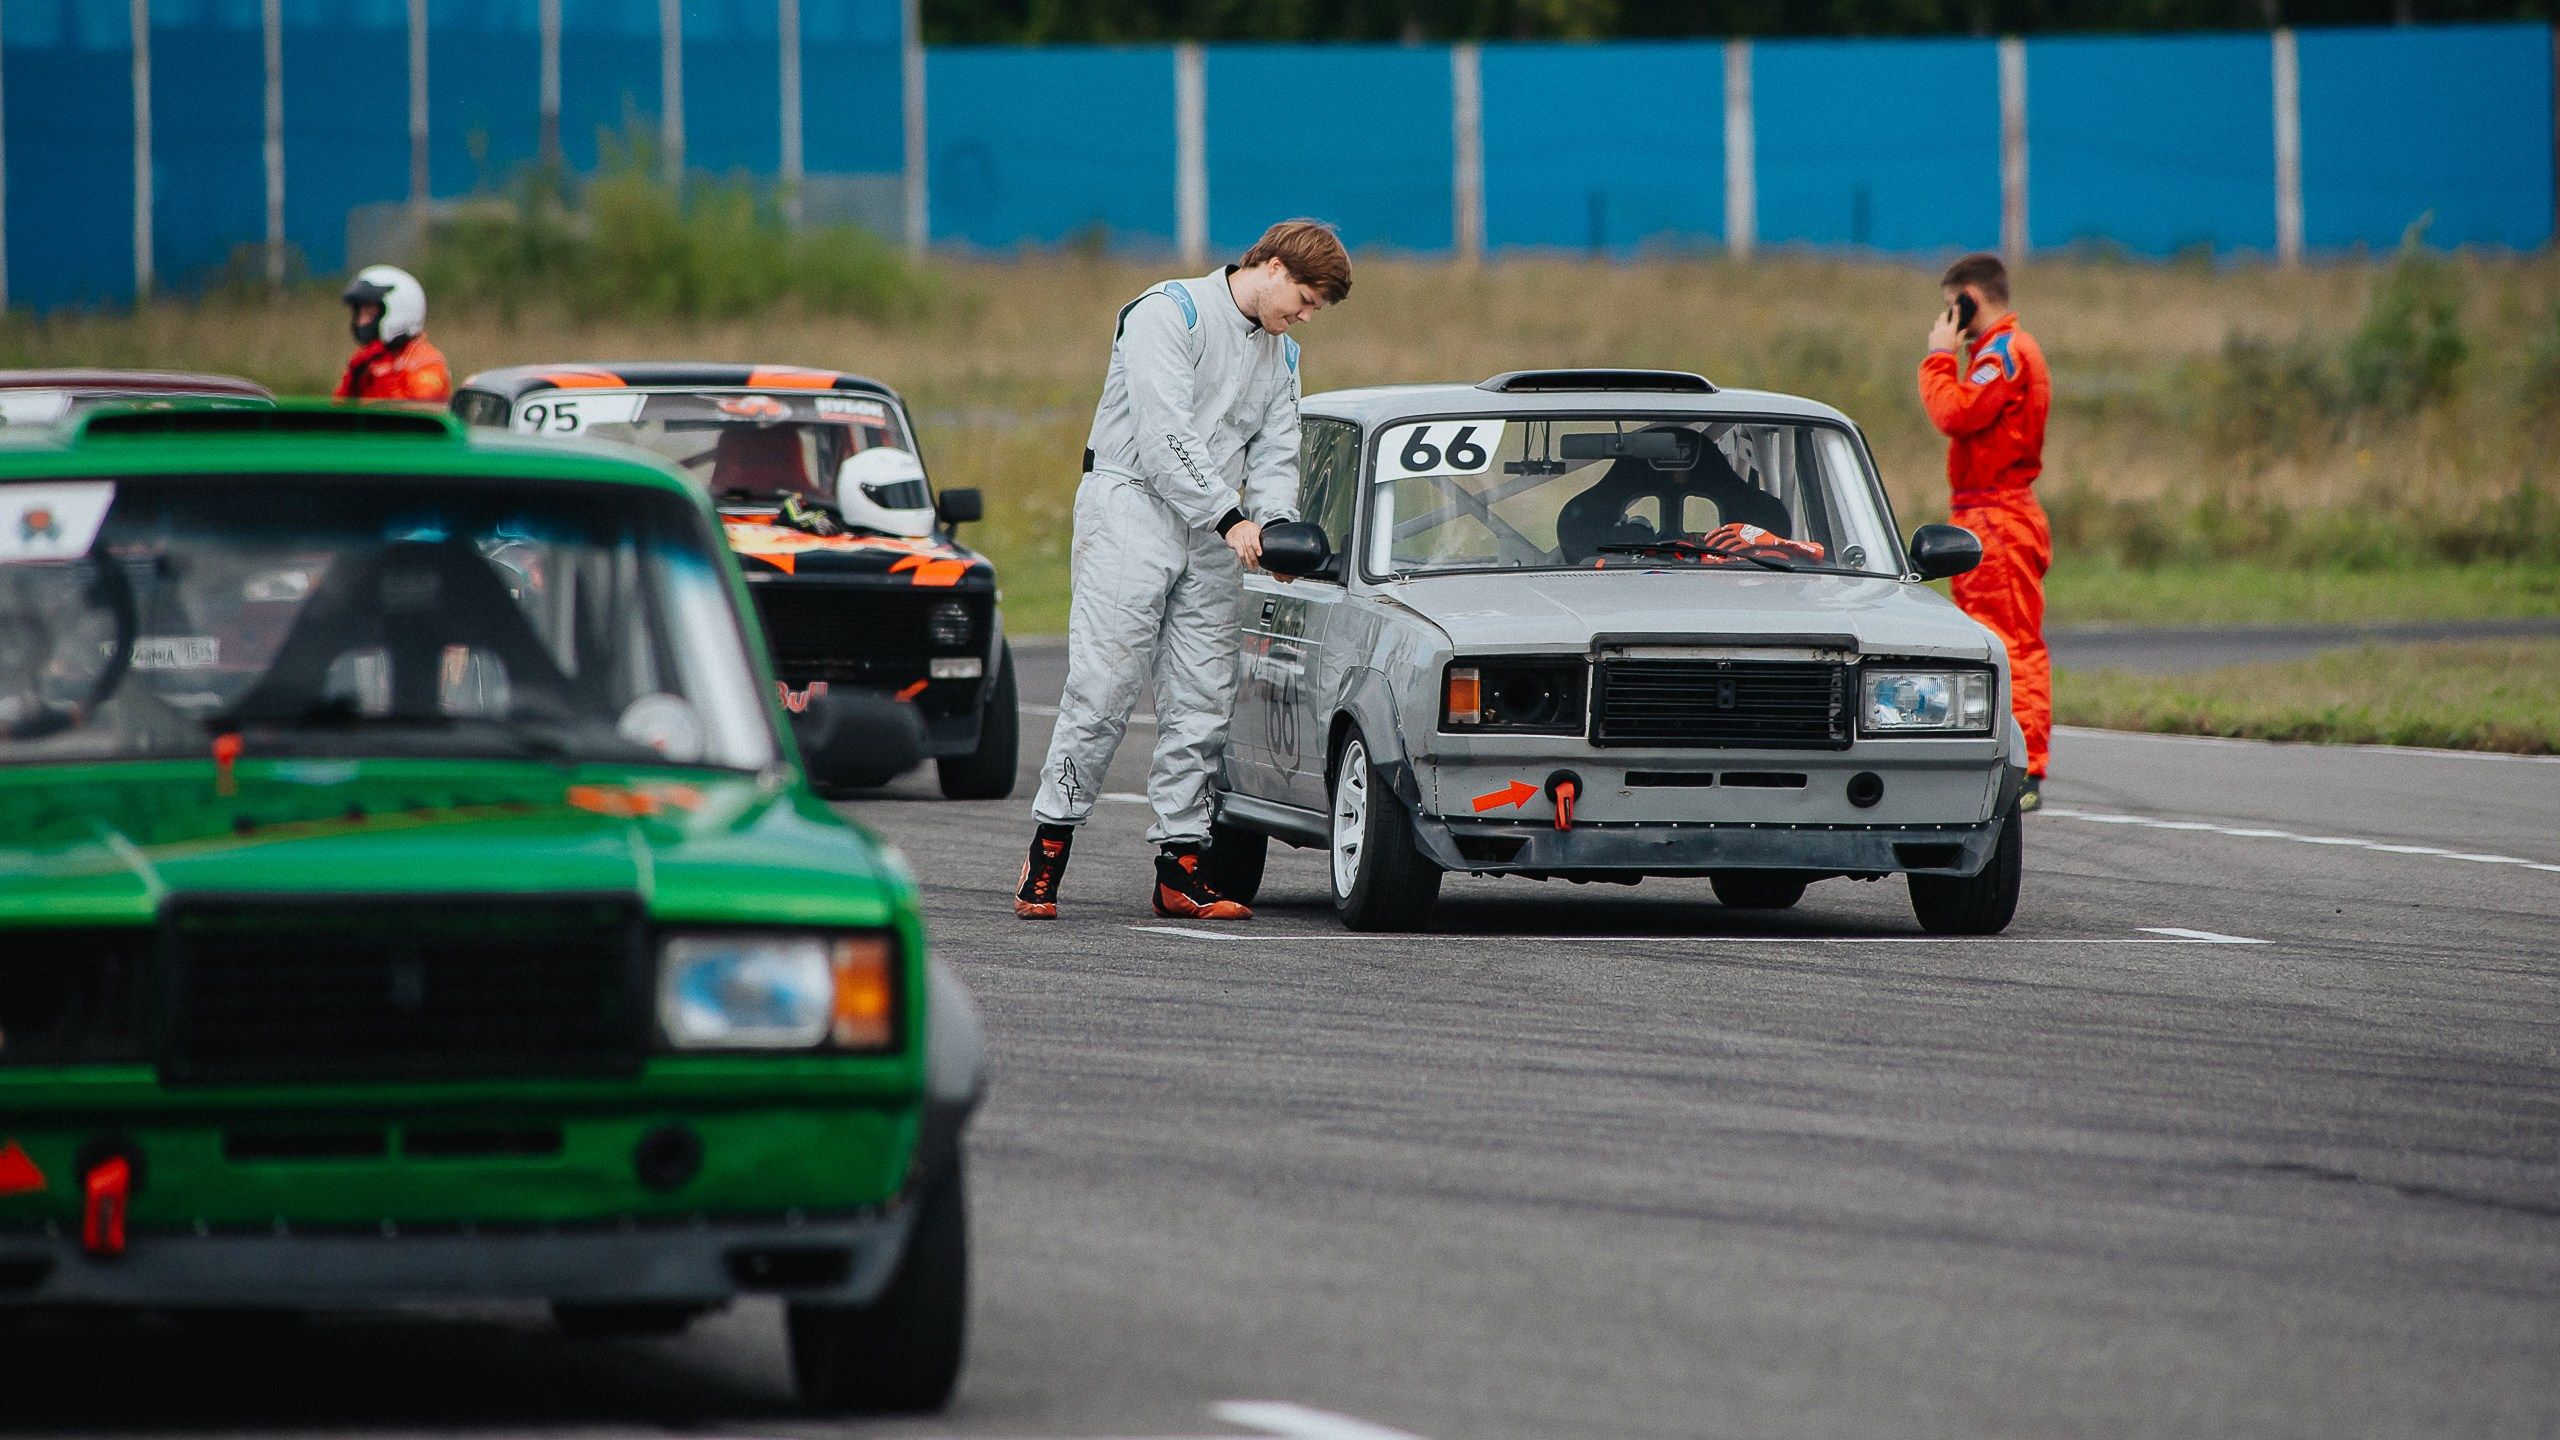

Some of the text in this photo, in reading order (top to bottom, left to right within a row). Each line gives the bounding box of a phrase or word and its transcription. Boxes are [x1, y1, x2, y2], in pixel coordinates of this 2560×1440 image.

[524, 402, 578, 432] 95
[1400, 425, 1487, 472] 66
[1269, 667, 1295, 757] 66
